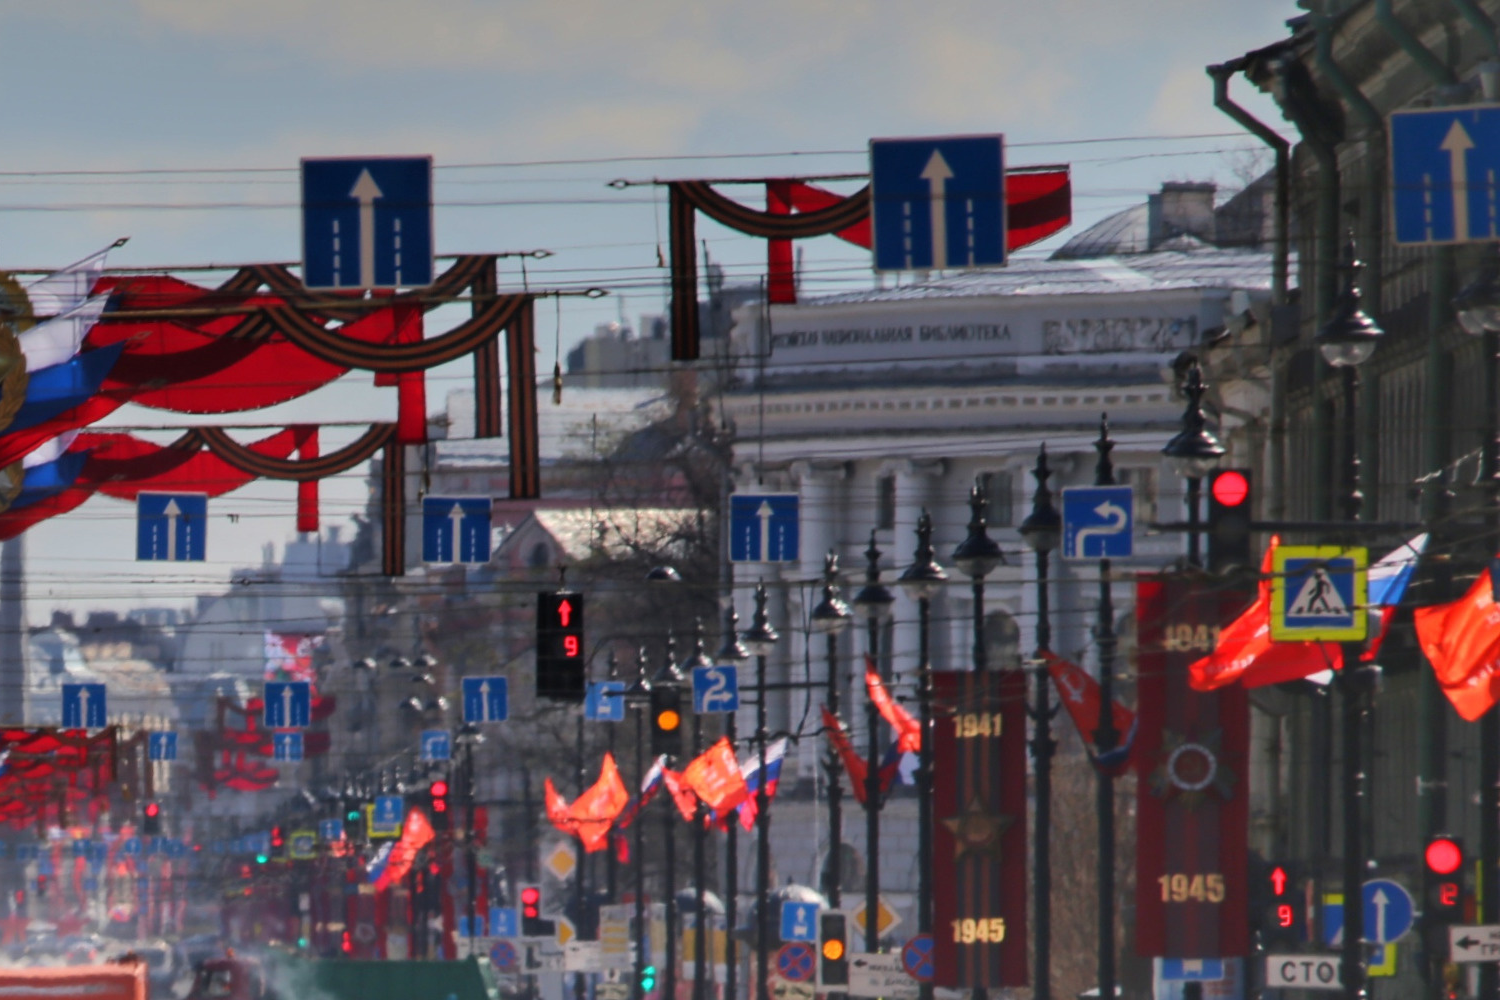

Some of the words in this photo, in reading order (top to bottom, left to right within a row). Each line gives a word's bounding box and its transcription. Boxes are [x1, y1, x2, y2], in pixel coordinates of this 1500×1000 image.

[564, 635, 579, 657] 9
[951, 713, 1002, 738] 1941
[1158, 874, 1225, 903] 1945
[1277, 904, 1293, 927] 9
[951, 918, 1006, 943] 1945
[1280, 961, 1338, 983] СТО
